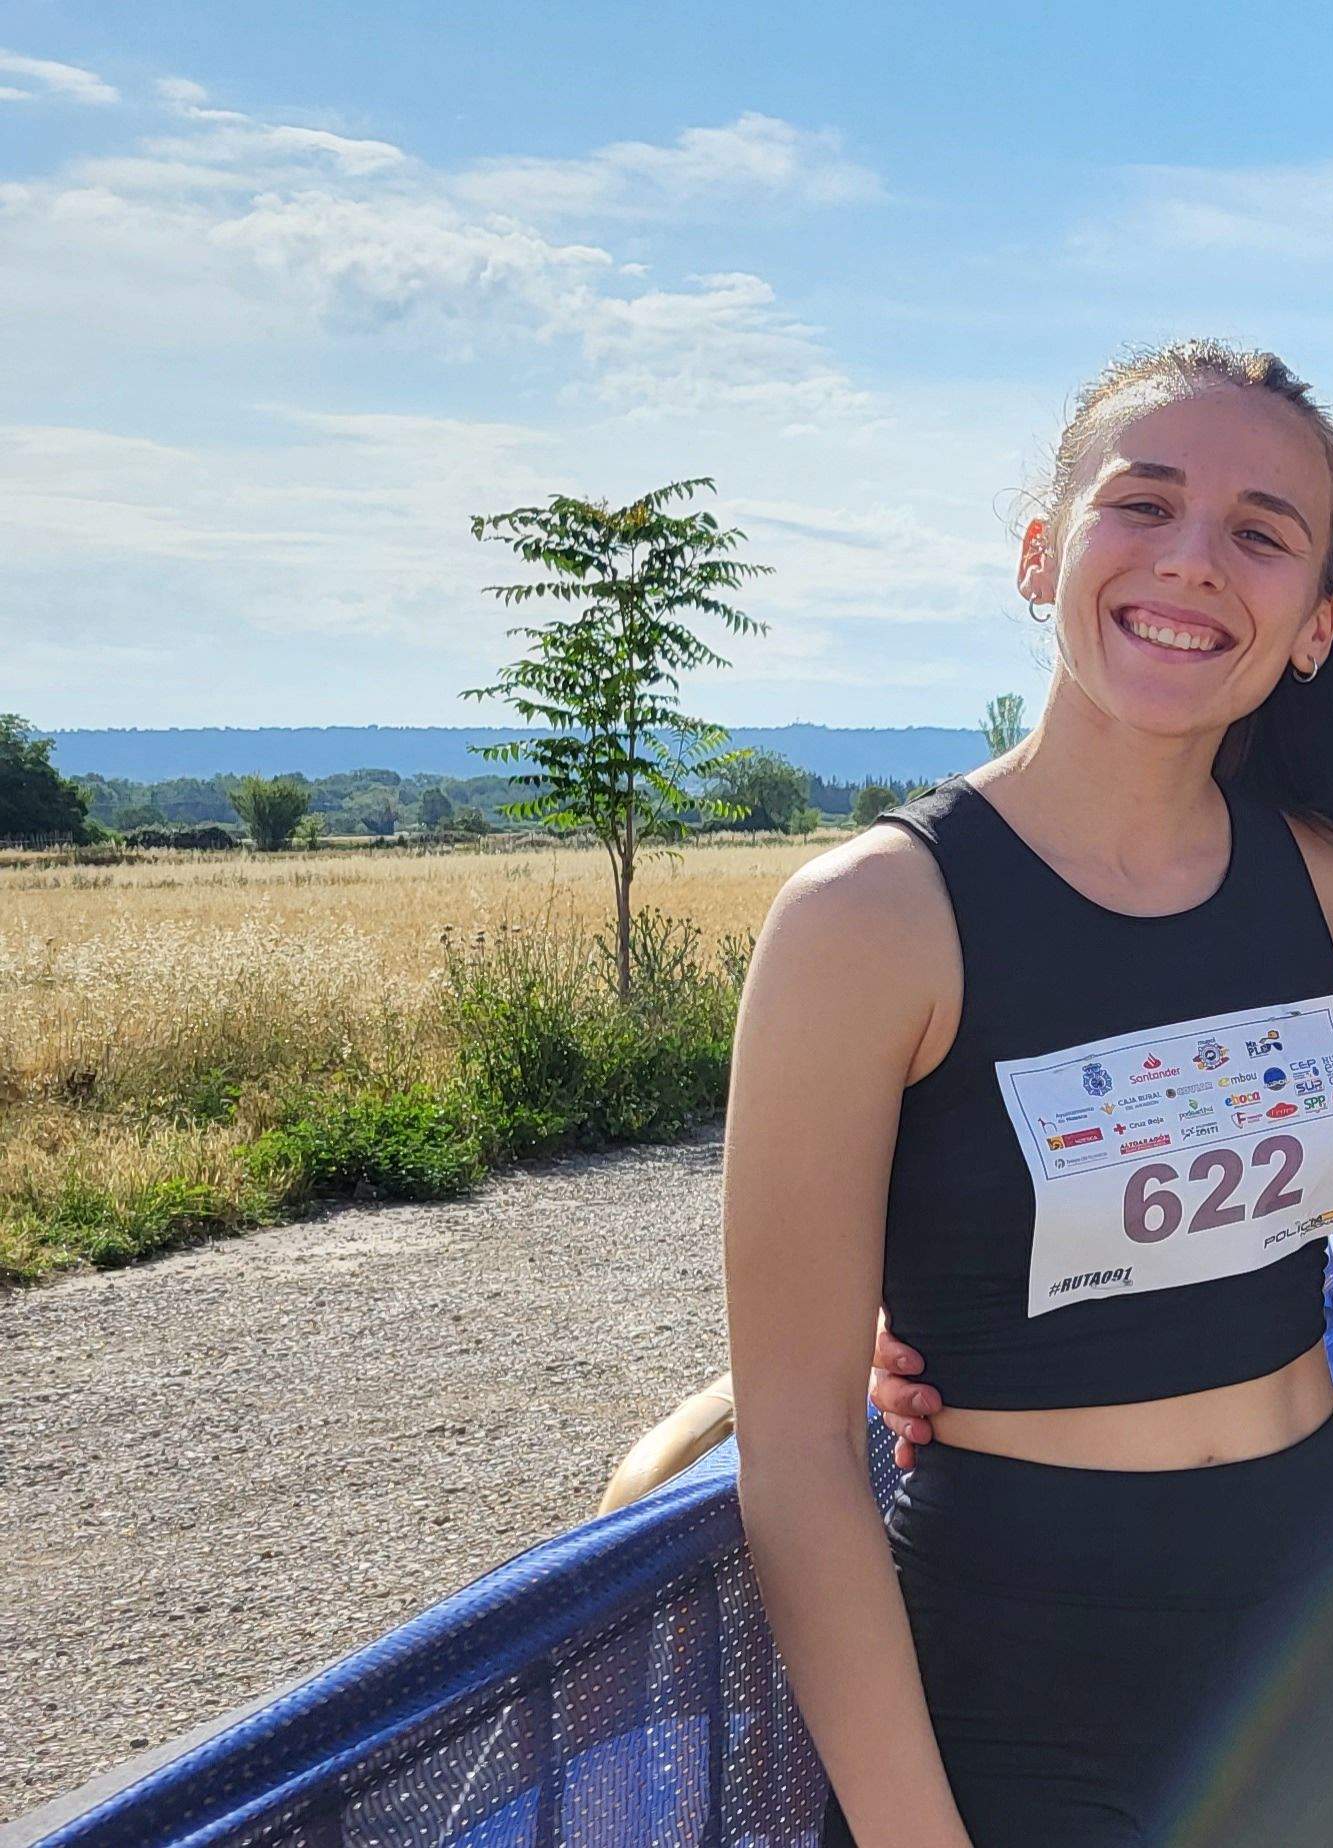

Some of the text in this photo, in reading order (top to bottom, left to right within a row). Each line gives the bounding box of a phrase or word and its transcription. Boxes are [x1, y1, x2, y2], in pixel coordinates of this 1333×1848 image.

[1290, 1059, 1316, 1071] CEP
[1130, 1068, 1180, 1085] Santander
[1225, 1091, 1260, 1106] eboca
[1123, 1134, 1304, 1244] 622
[1047, 1265, 1133, 1298] #RUTA091
